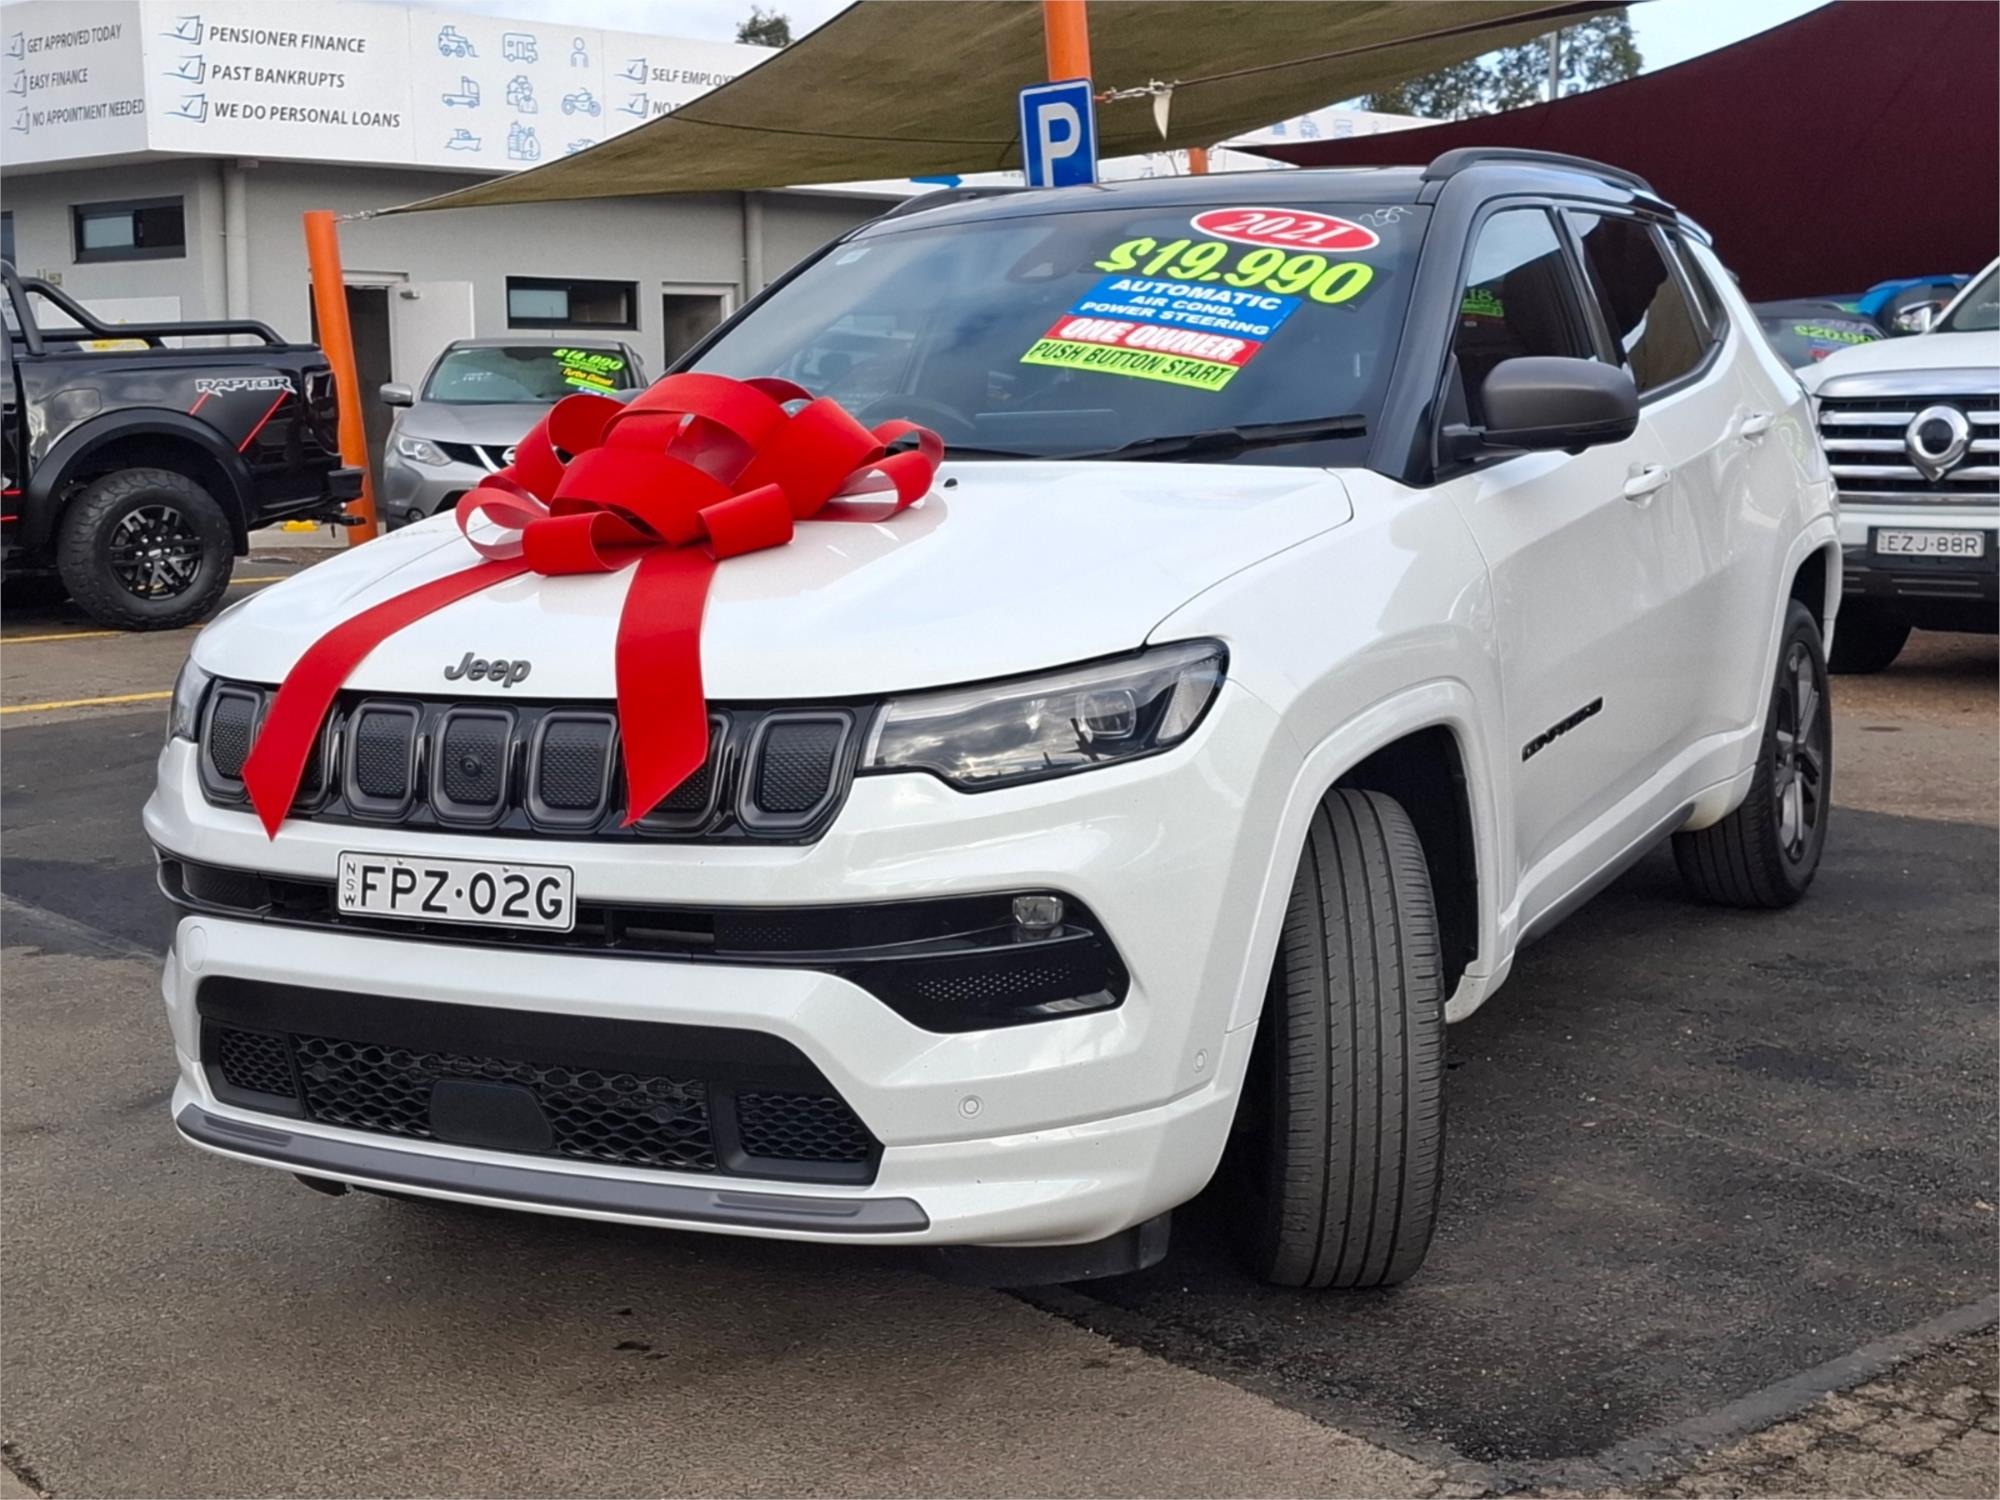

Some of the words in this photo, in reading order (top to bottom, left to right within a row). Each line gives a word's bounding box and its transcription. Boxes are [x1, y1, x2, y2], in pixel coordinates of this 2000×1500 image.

[27, 37, 43, 53] GET
[44, 29, 90, 51] APPROVED
[91, 24, 122, 43] TODAY
[209, 26, 298, 48] PENSIONER
[300, 34, 367, 53] FINANCE
[29, 72, 50, 90] EASY
[51, 67, 88, 88] FINANCE
[212, 64, 251, 82] PAST
[254, 67, 345, 88] BANKRUPTS
[652, 67, 680, 83] SELF
[681, 70, 738, 87] EMPLOY
[32, 111, 45, 127] NO
[46, 103, 108, 125] APPOINTMENT
[108, 98, 145, 118] NEEDED
[214, 102, 239, 118] WE
[242, 104, 266, 120] DO
[269, 106, 348, 125] PERSONAL
[352, 111, 400, 128] LOANS
[652, 101, 672, 115] NO
[1038, 101, 1081, 187] P
[1212, 213, 1354, 244] 2021
[1109, 278, 1282, 311] AUTOMATIC
[1129, 295, 1169, 307] AIR
[1171, 299, 1236, 317] COND.
[1080, 301, 1158, 318] POWER
[1158, 309, 1270, 336] STEERING
[1059, 317, 1136, 344] ONE
[1124, 325, 1246, 361] OWNER
[1031, 341, 1086, 360] PUSH
[1084, 347, 1164, 372] BUTTON
[1161, 359, 1234, 384] START
[195, 376, 297, 397] RAPTOR
[444, 652, 531, 688] Jeep
